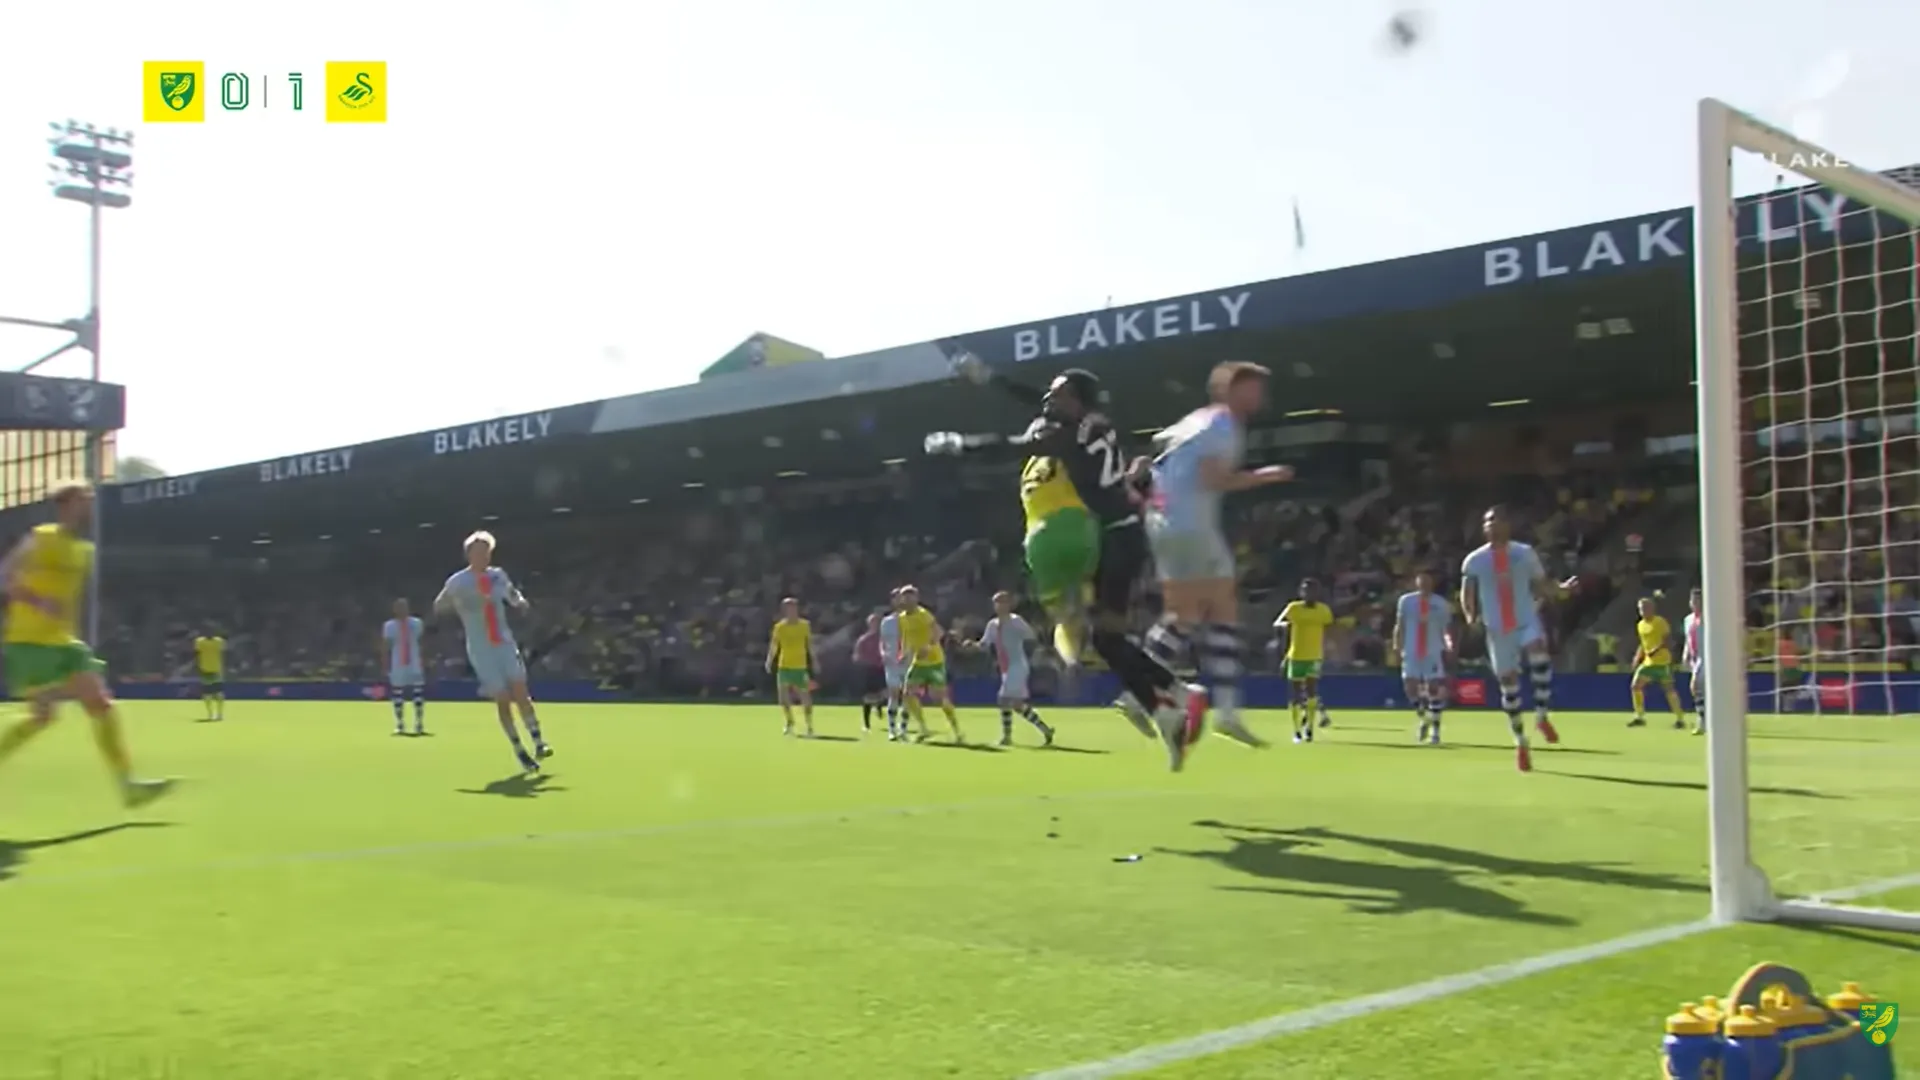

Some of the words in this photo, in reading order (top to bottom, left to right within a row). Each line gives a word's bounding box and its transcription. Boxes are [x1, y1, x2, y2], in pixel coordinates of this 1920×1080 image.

[1485, 193, 1848, 287] BLAKLY
[1014, 292, 1251, 362] BLAKELY
[434, 412, 554, 455] BLAKELY
[260, 450, 354, 483] BLAKELY
